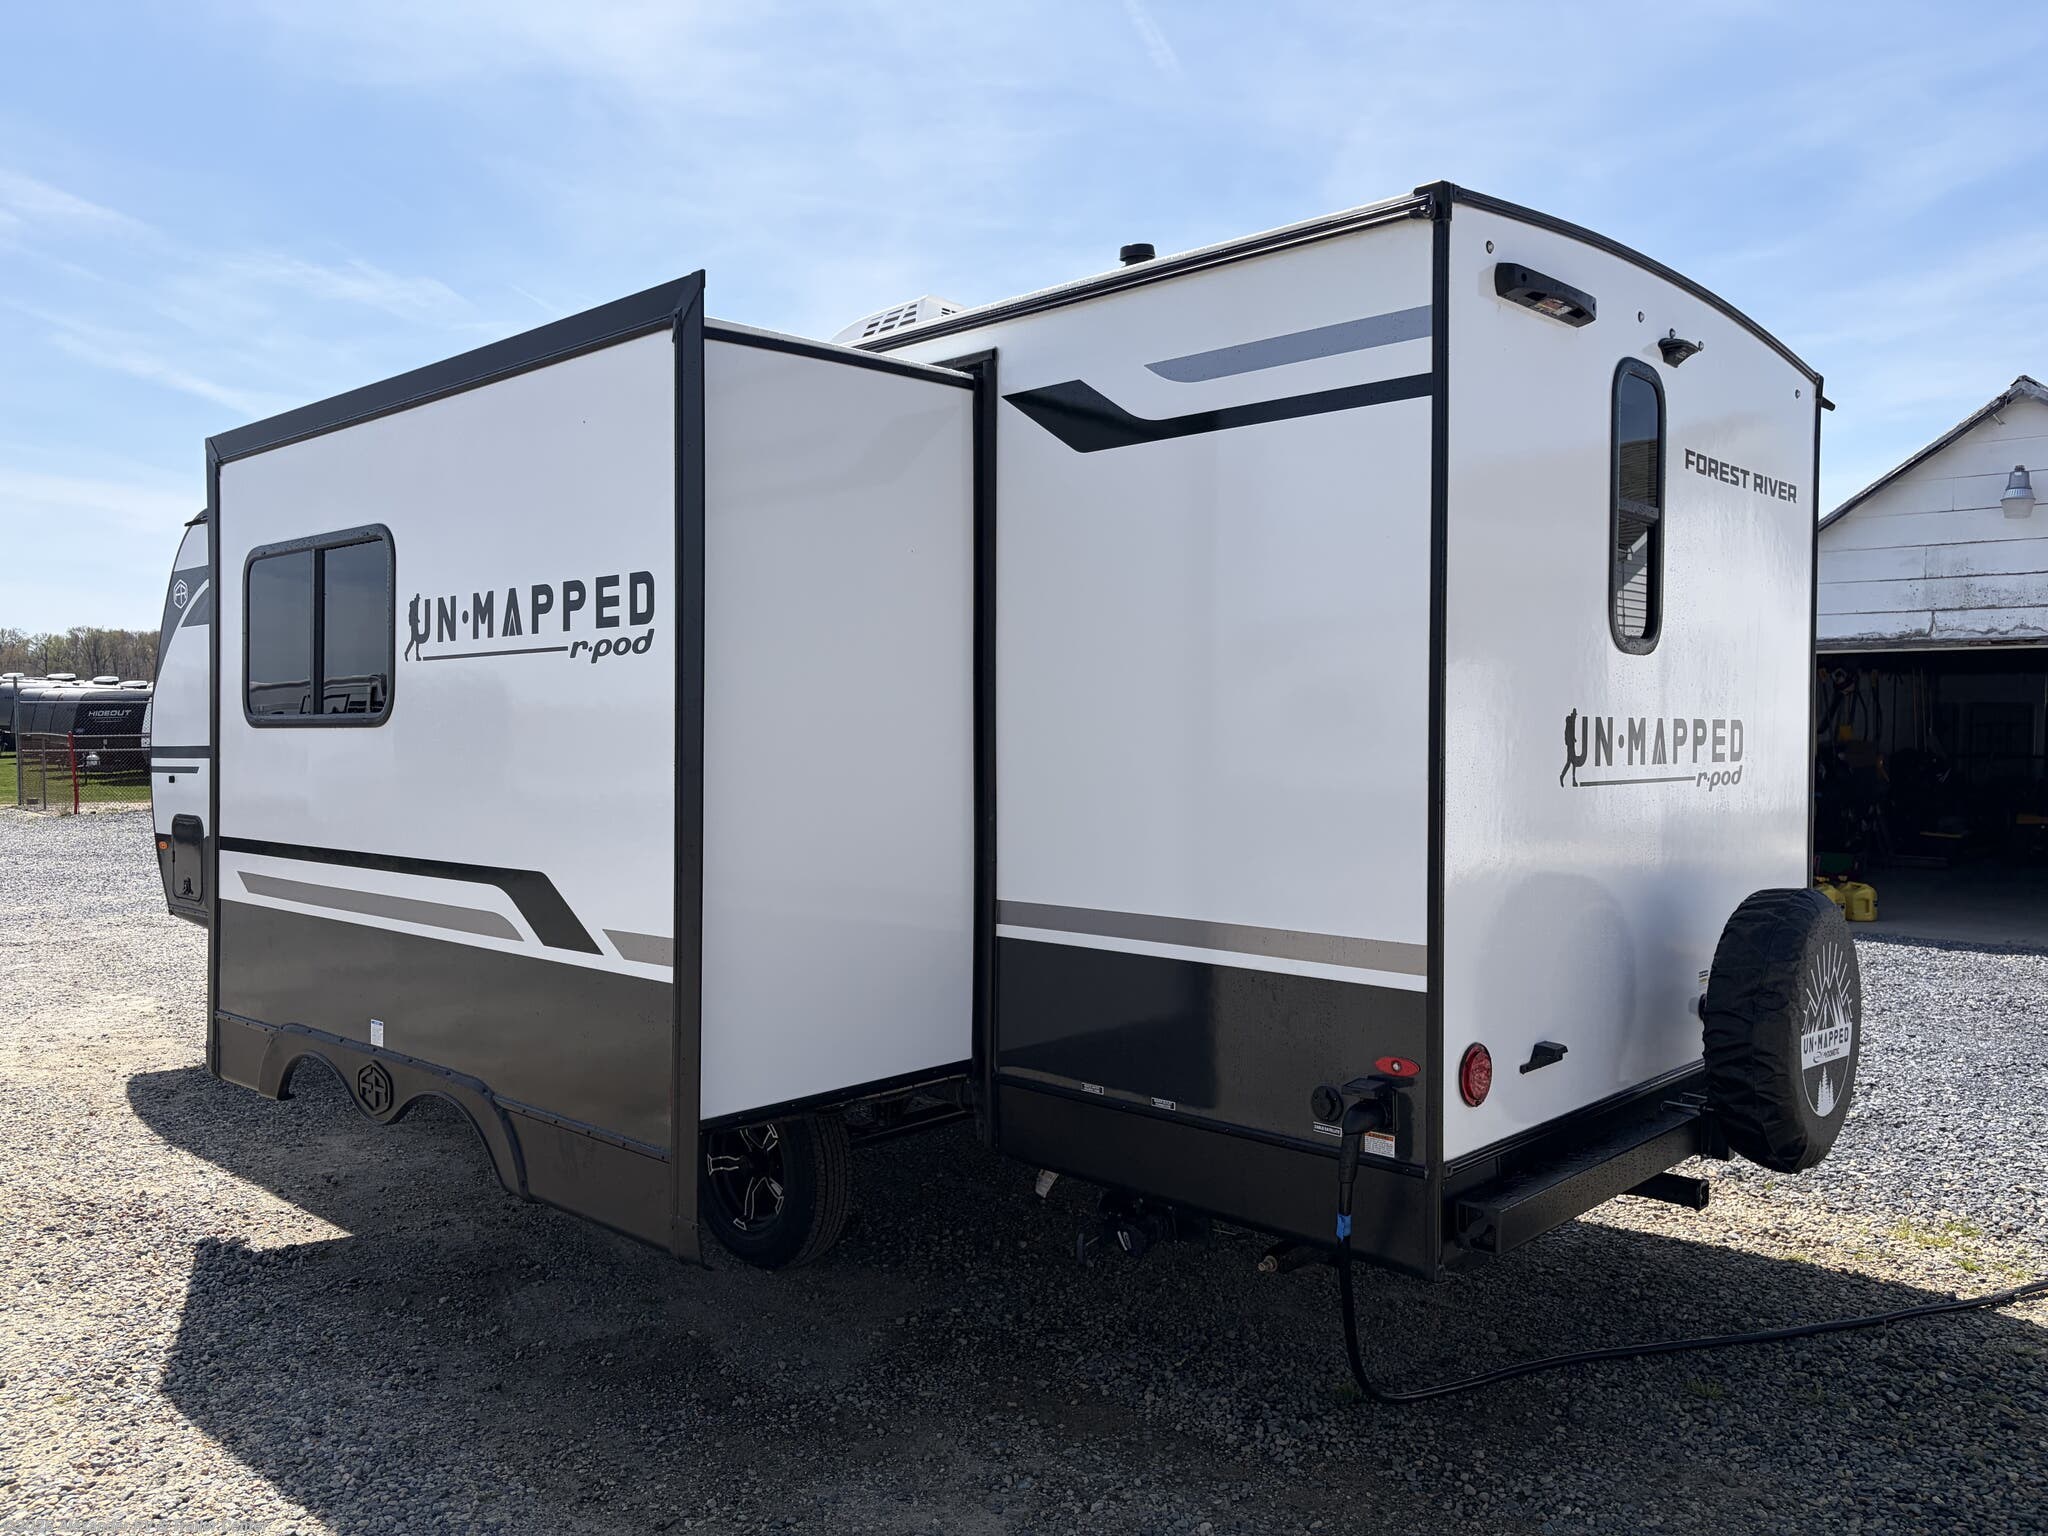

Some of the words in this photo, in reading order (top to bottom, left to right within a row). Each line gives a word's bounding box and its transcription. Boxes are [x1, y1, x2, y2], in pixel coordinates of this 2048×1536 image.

[1685, 448, 1750, 489] FOREST
[1753, 472, 1797, 504] RIVER
[88, 709, 132, 717] HIDEOUT
